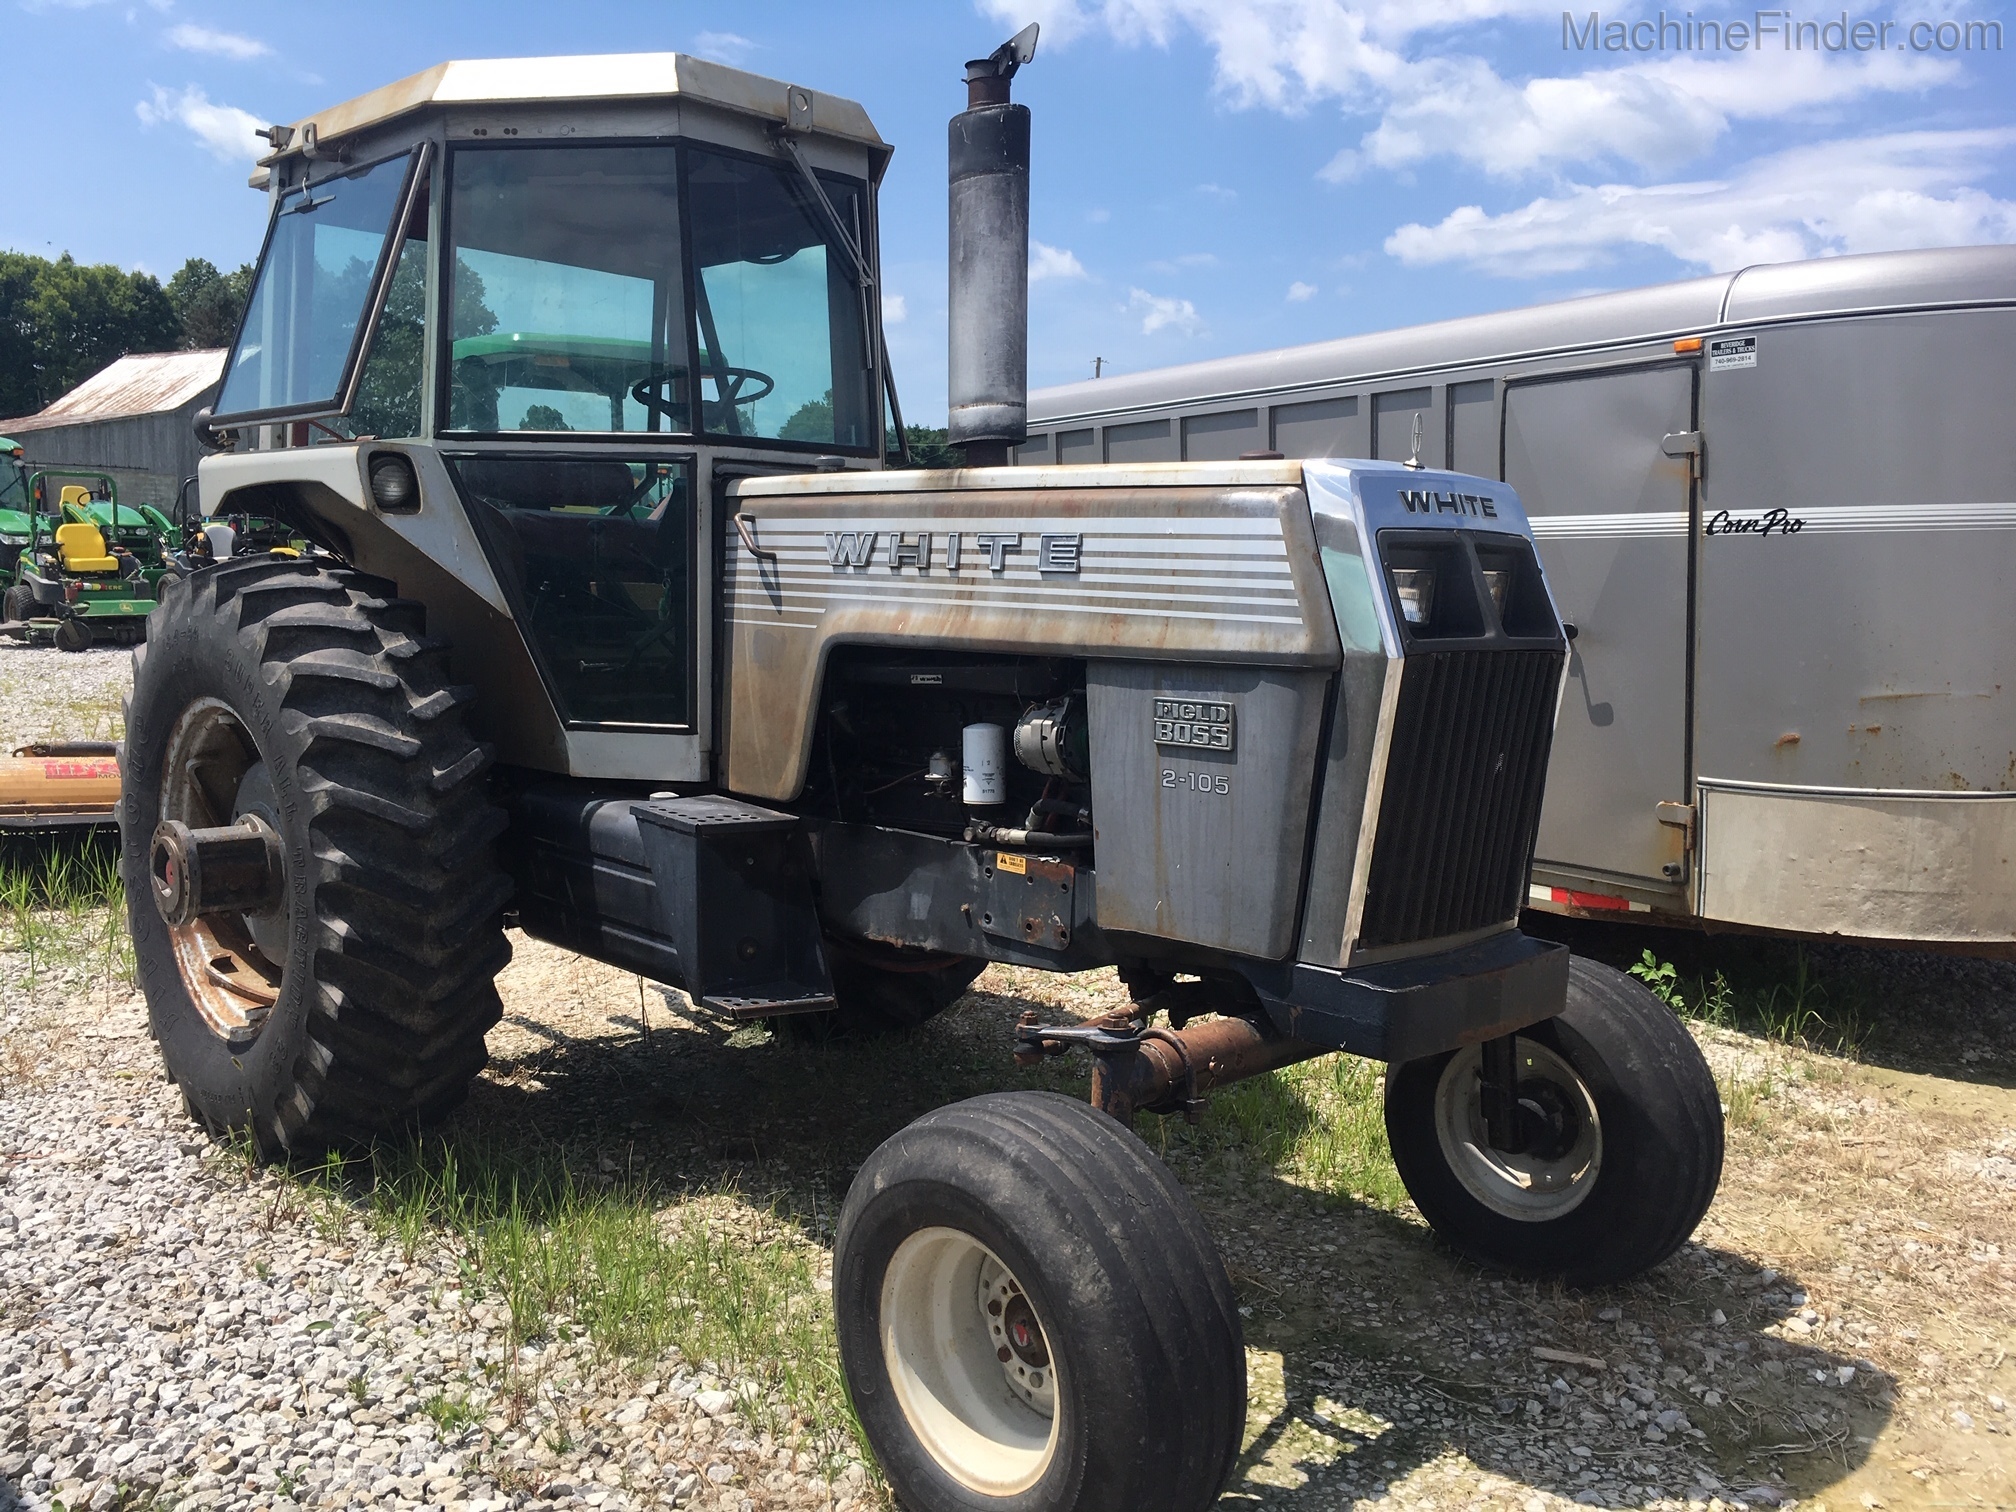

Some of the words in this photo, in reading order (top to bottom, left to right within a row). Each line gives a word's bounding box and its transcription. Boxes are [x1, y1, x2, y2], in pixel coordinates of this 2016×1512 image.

[1711, 348, 1732, 356] TRAILERS
[1737, 345, 1756, 353] TRUCKS
[1720, 340, 1746, 349] BEVERIDGE
[1397, 489, 1498, 519] WHITE
[824, 531, 1084, 574] WHITE
[1155, 701, 1227, 722] FIELD
[1155, 721, 1228, 747] BOSS
[1162, 768, 1230, 795] 2-105
[285, 845, 309, 1030] TRACTION
